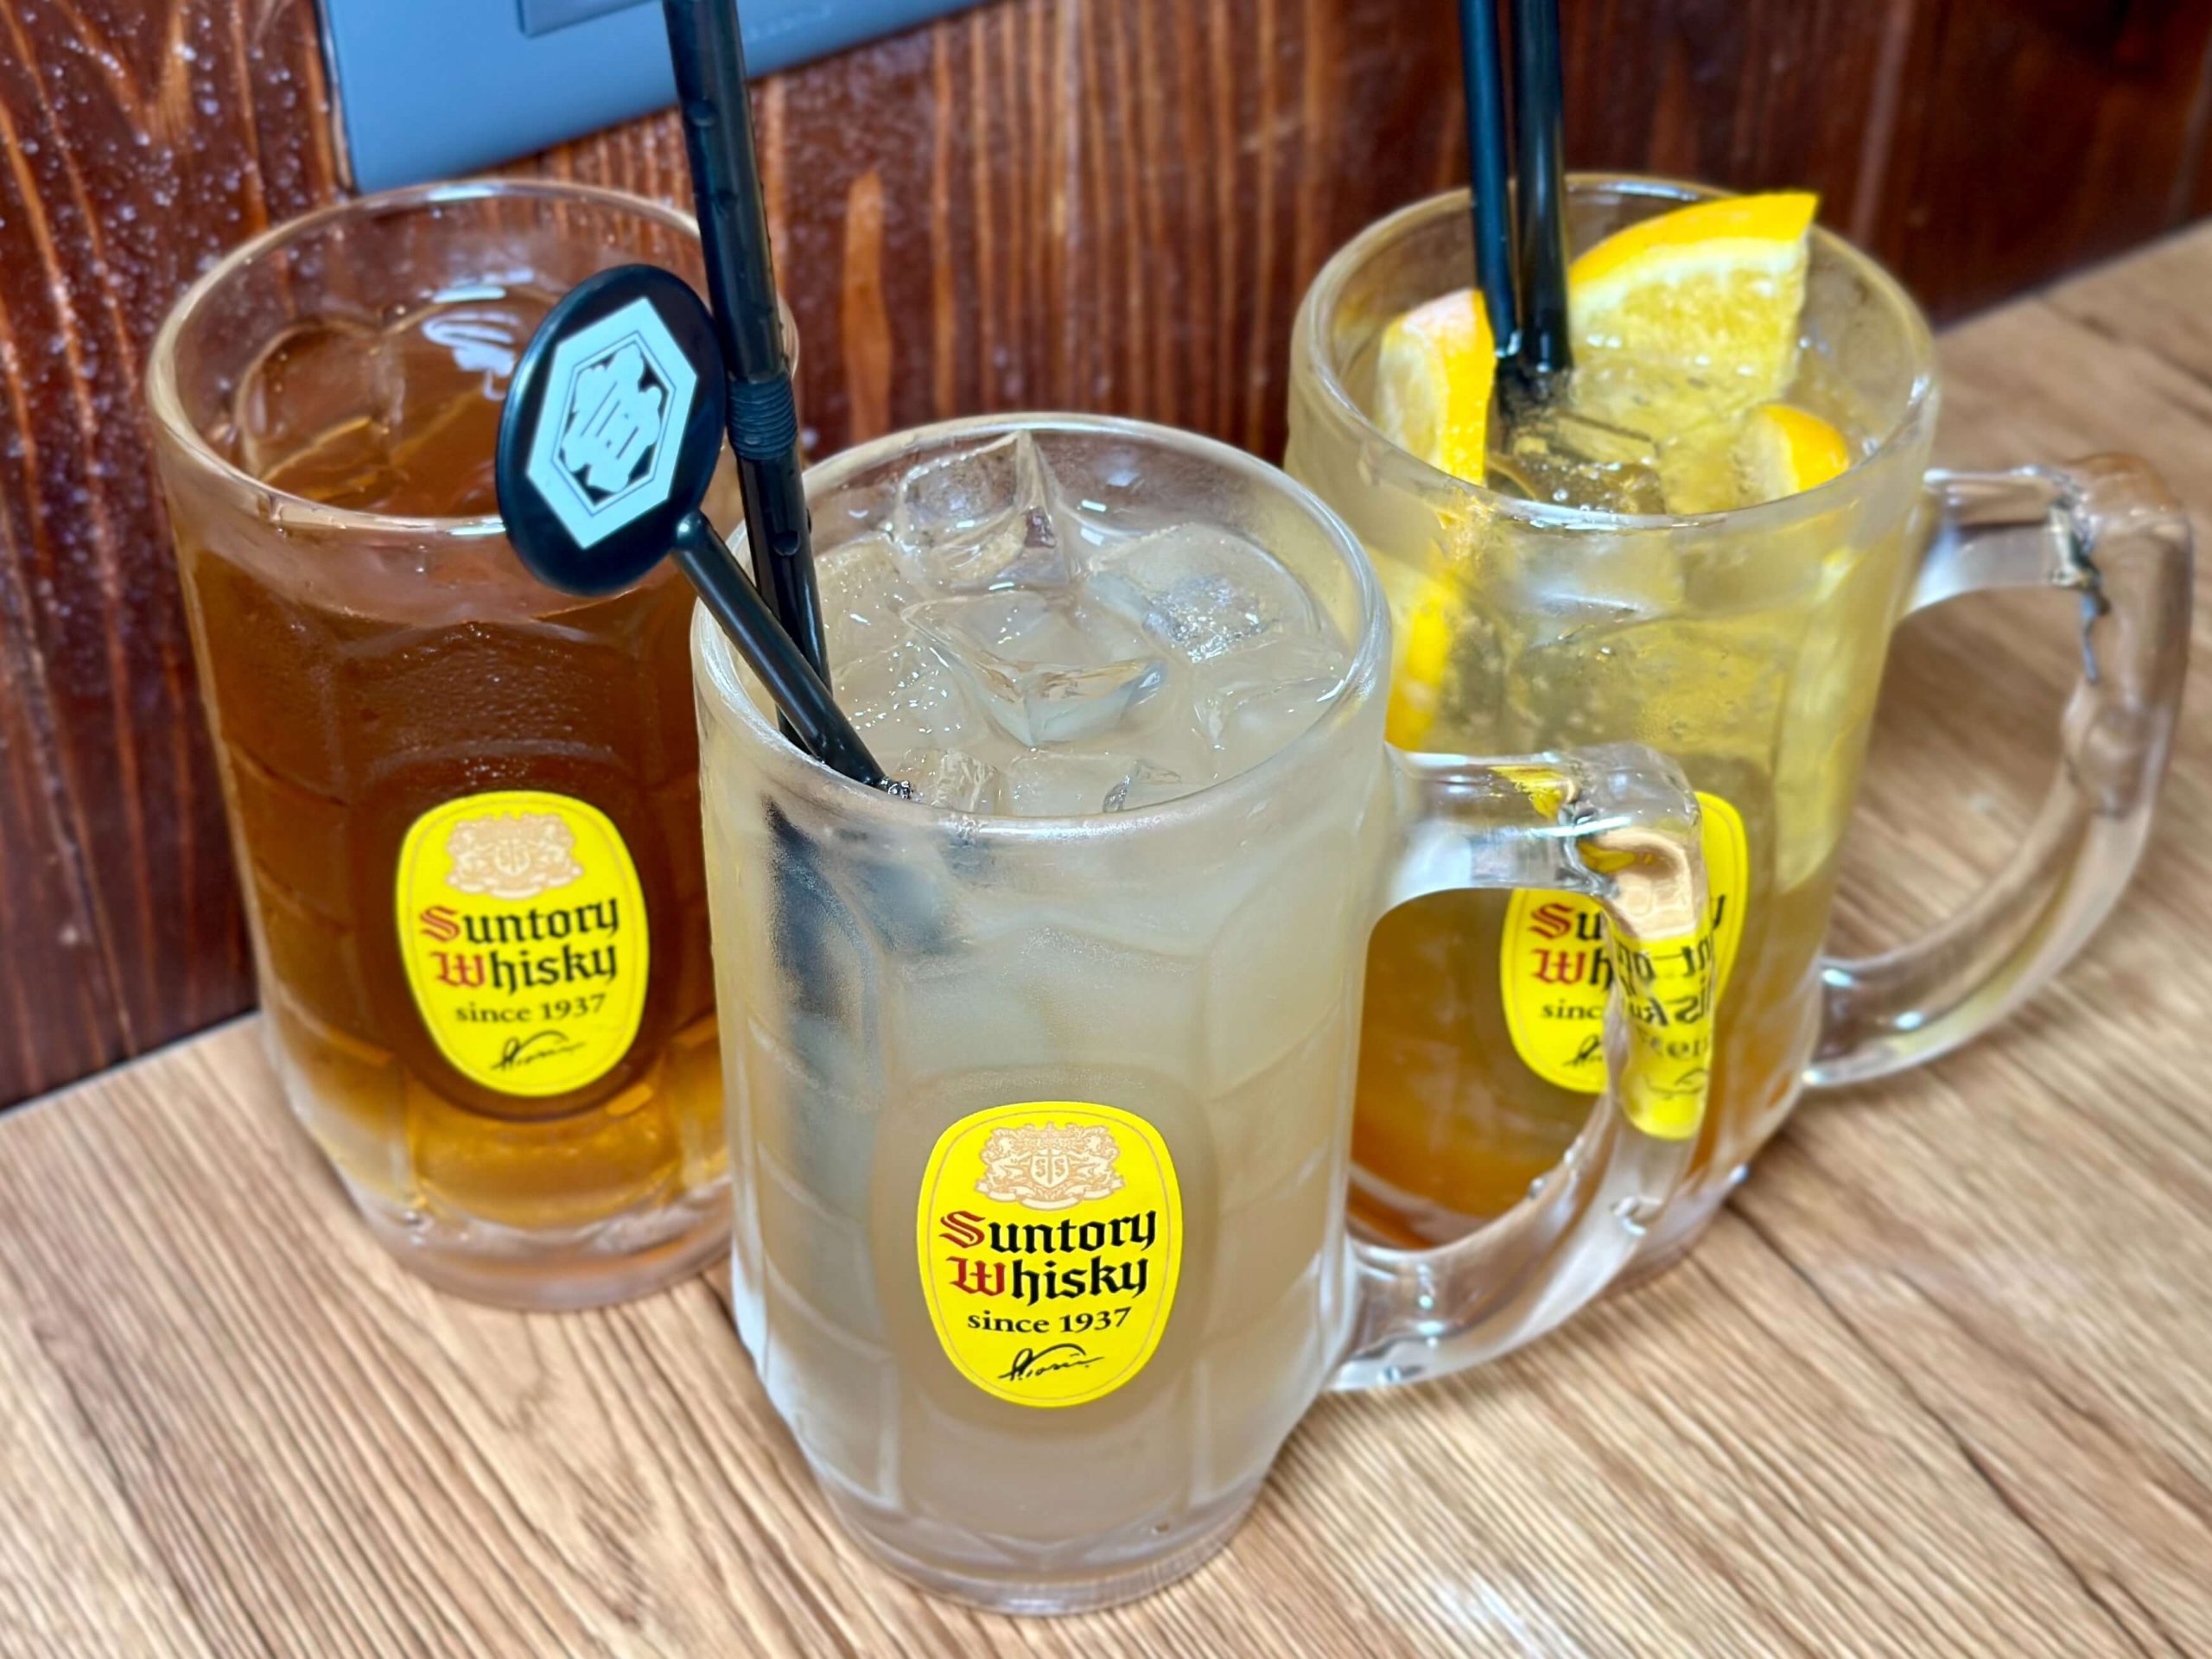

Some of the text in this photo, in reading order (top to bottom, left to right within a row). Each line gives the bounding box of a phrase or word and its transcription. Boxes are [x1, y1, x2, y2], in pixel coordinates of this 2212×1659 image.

[419, 898, 620, 945] Suntory
[429, 944, 617, 995] Whisky
[455, 993, 607, 1024] since 1937
[1541, 998, 1602, 1020] sinc
[939, 1210, 1157, 1254] Suntory
[945, 1255, 1149, 1306] Whisky
[967, 1306, 1131, 1333] since 1937
